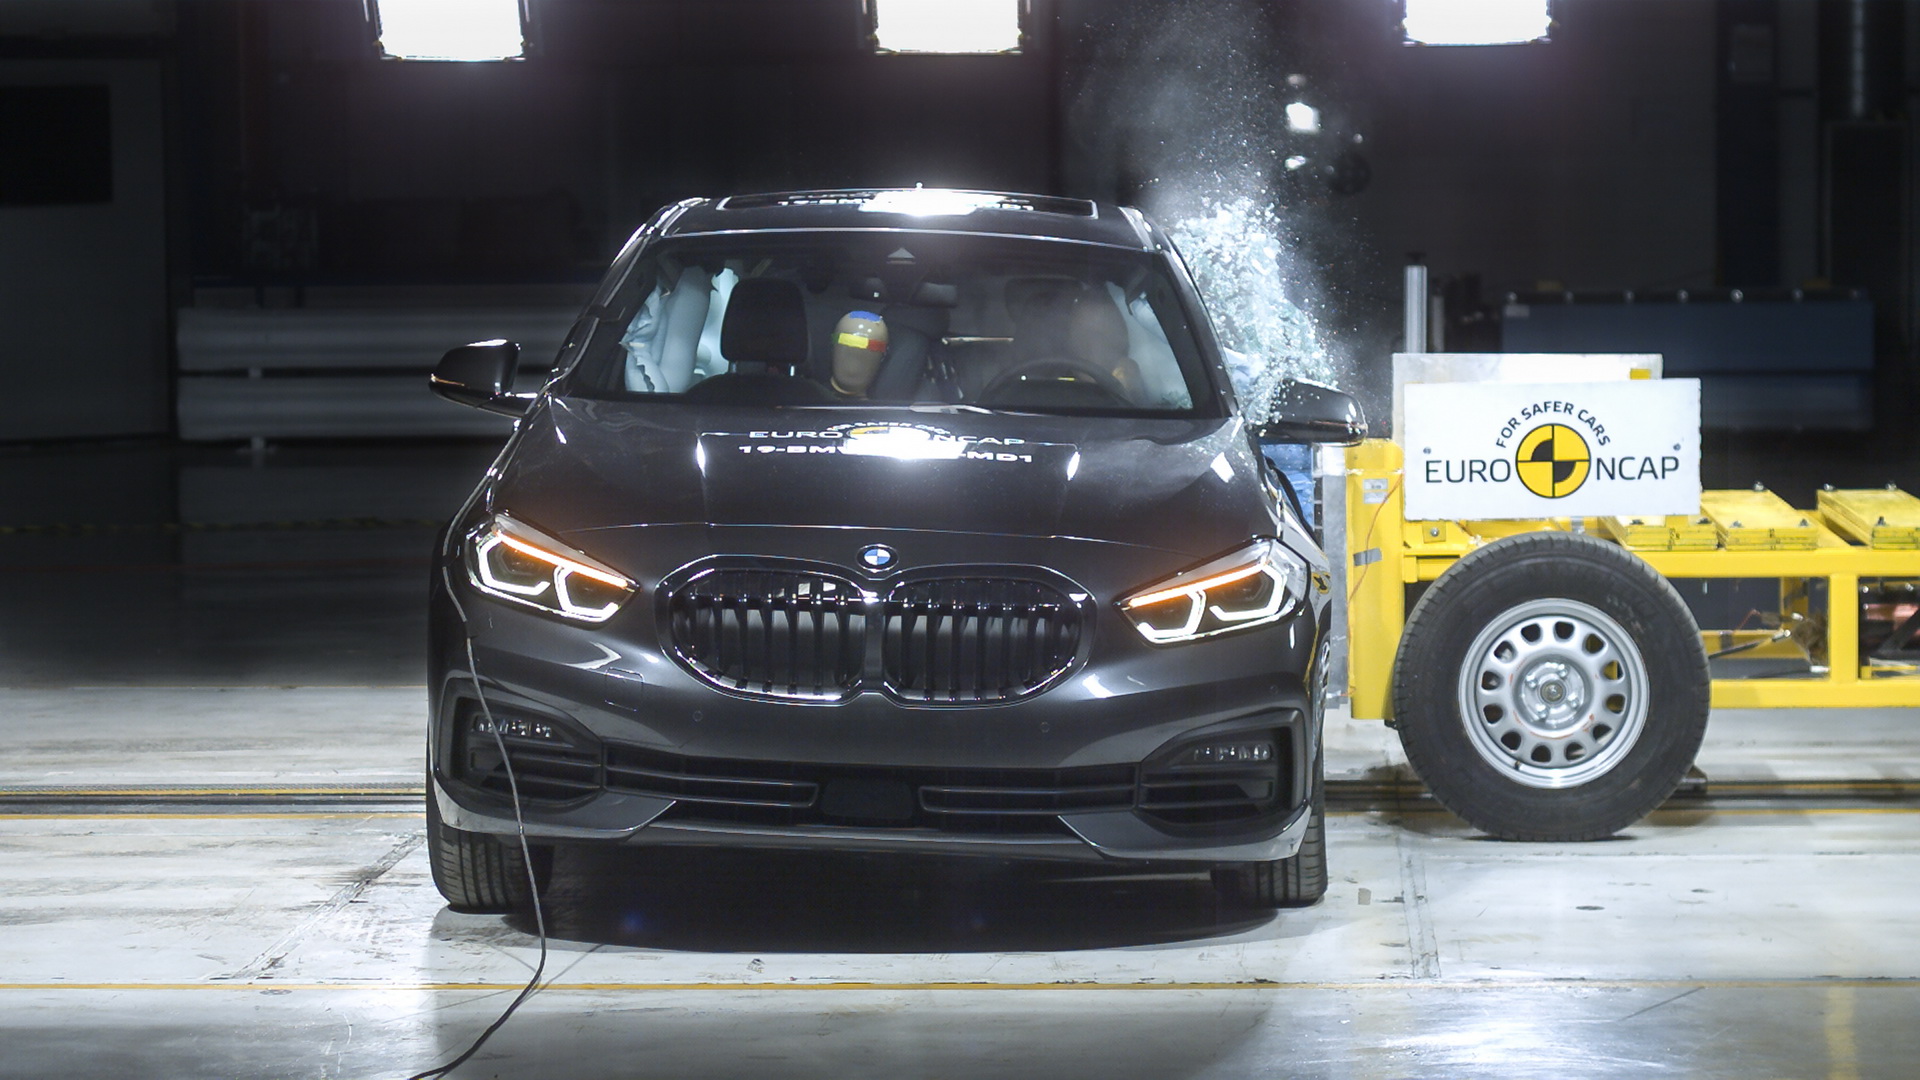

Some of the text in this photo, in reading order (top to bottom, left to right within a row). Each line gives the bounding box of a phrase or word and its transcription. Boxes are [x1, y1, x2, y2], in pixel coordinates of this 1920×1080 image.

[1496, 401, 1611, 448] FOR SAFER CARS
[932, 434, 1025, 445] NCAP
[738, 445, 845, 454] 19-BM
[1425, 456, 1679, 483] EURO NCAP
